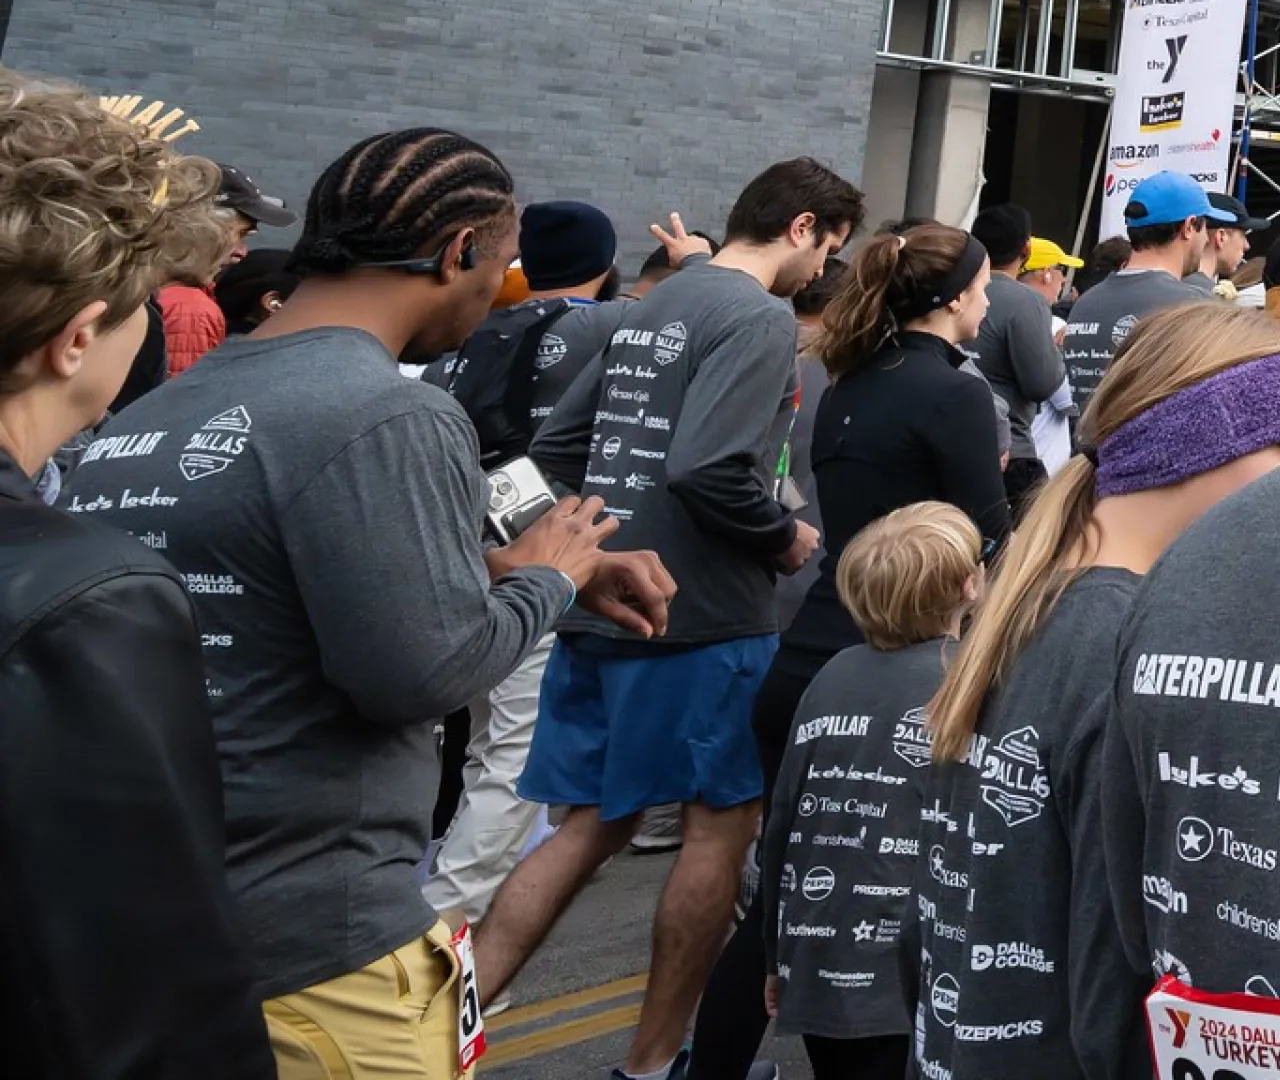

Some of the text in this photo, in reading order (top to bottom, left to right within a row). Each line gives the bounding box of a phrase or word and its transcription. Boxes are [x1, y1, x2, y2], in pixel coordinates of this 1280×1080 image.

[1147, 60, 1165, 70] the
[1110, 144, 1160, 160] amazon
[184, 432, 247, 455] DALLAS
[120, 486, 178, 509] locker
[187, 574, 234, 584] DALLAS
[187, 584, 244, 595] COLLEGE
[892, 724, 932, 743] DALL
[981, 755, 1050, 798] DALLAS
[1159, 752, 1261, 795] luke's
[1217, 827, 1277, 870] Texas
[804, 877, 833, 889] PEPSI
[853, 885, 911, 896] PRIZEPICK
[1200, 1017, 1237, 1040] 2024
